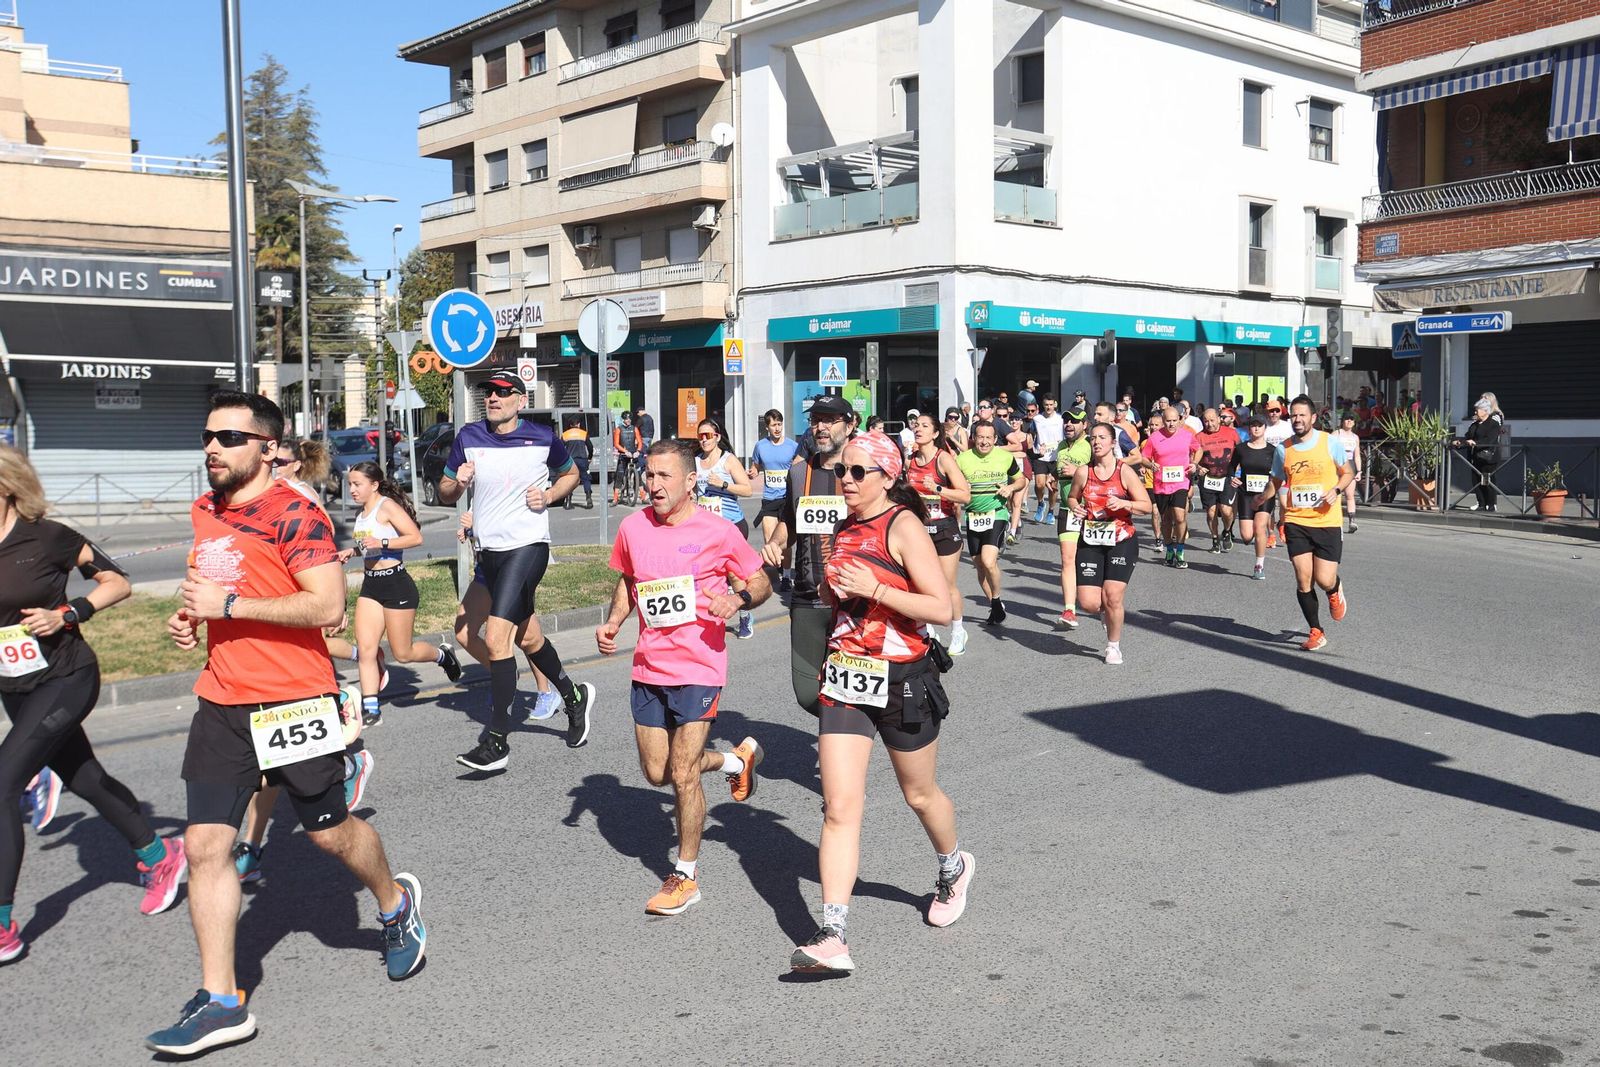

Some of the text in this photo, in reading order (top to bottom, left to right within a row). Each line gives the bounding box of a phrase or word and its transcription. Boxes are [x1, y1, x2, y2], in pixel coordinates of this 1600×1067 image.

[0, 265, 149, 291] JARDINES
[167, 277, 217, 288] CUMBAL
[1434, 277, 1545, 303] RESTAURANTE
[495, 305, 542, 326] ASESRIA
[974, 308, 986, 320] 24
[1032, 313, 1067, 329] cajamar
[820, 318, 852, 333] cajamar
[1146, 321, 1177, 335] cajamar
[1418, 318, 1490, 330] Granada A-44
[647, 334, 672, 347] cajamar
[1245, 327, 1272, 340] cajamar
[61, 363, 152, 379] JARDINES
[1166, 471, 1181, 479] 154
[1207, 479, 1221, 487] 249
[1296, 492, 1318, 502] 118
[803, 508, 839, 524] 698
[973, 517, 991, 527] 998
[1085, 528, 1114, 540] 3177
[373, 568, 394, 577] PRO
[646, 594, 686, 616] 526
[0, 641, 37, 664] 96
[828, 664, 885, 695] 3137
[268, 719, 328, 750] 453
